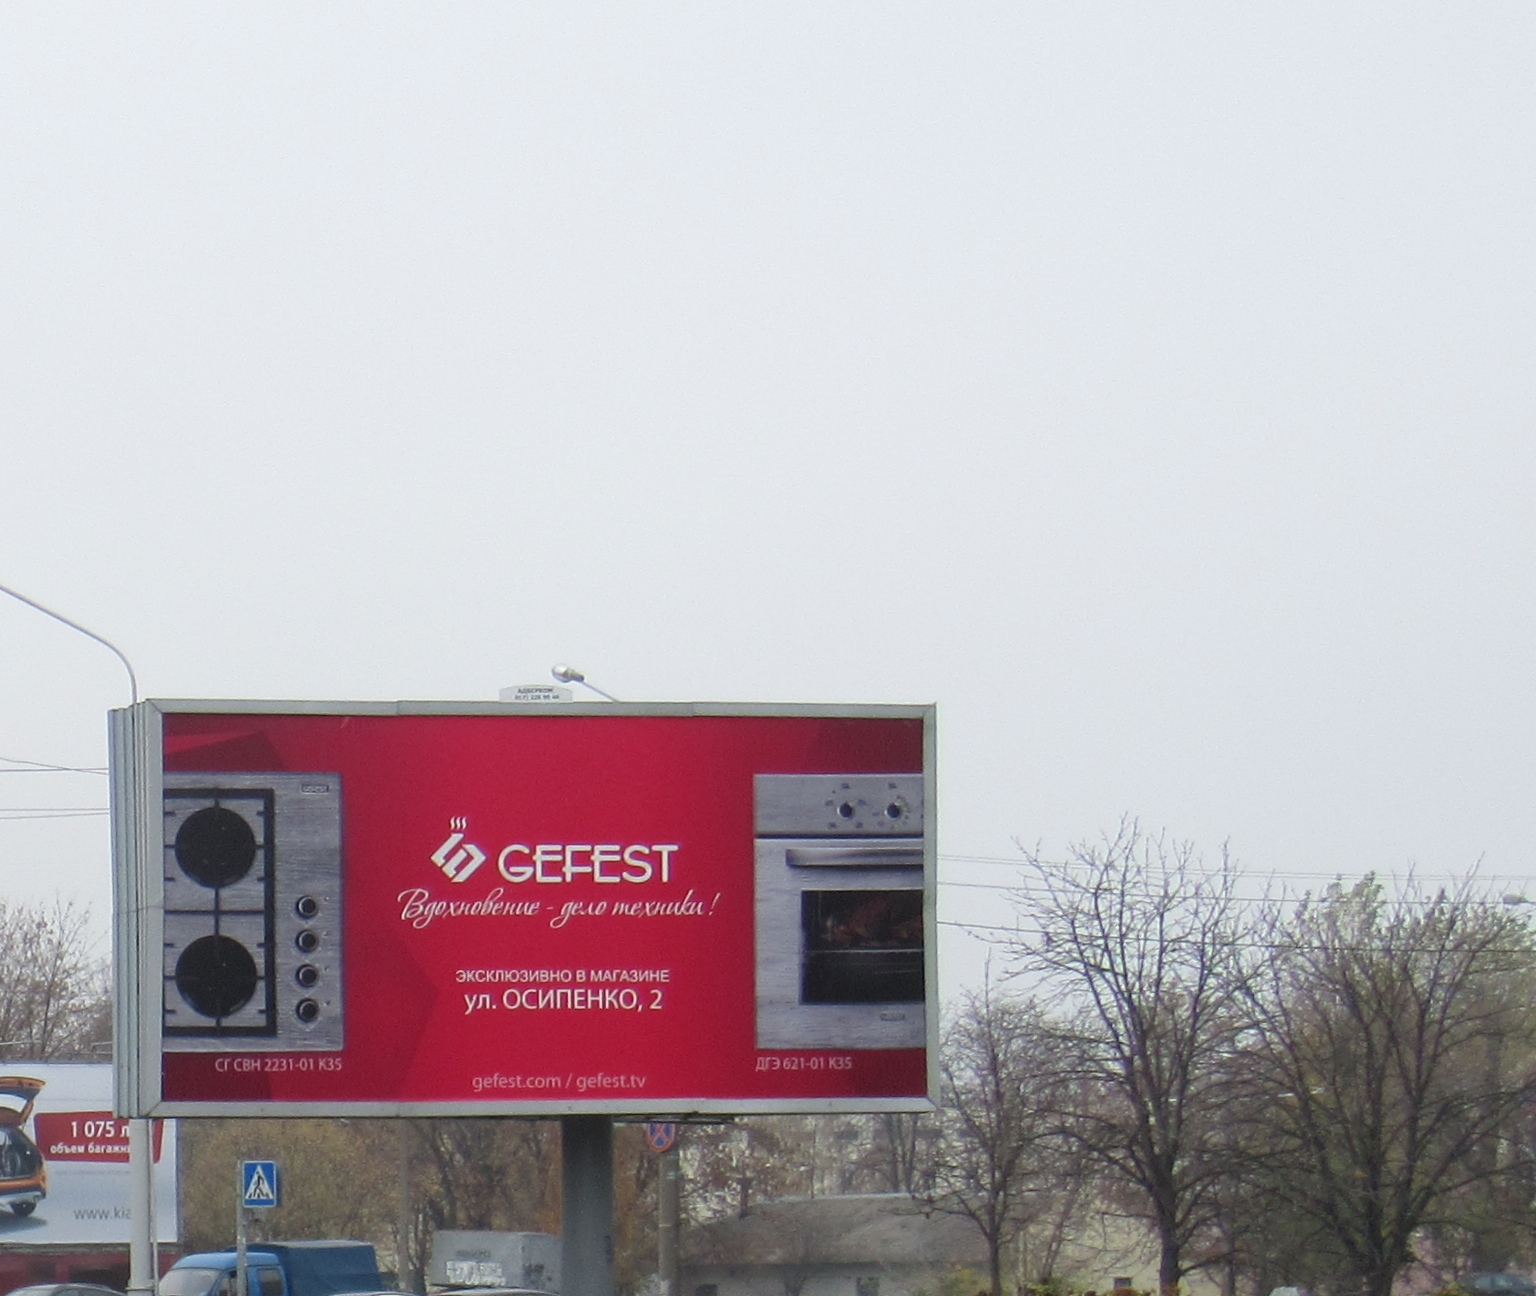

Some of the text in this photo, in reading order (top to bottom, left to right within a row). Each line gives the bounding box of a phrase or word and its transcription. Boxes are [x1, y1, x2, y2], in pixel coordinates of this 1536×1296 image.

[496, 844, 679, 883] GEFEST
[396, 887, 541, 929] Вдохновение
[549, 900, 608, 929] дело
[455, 969, 670, 984] ЭКСКЛЮЗИВНО В МАГАЗИНЕ
[463, 988, 664, 1015] ул. ОСИПЕНКО, 2
[263, 1058, 315, 1072] 2231-01
[755, 1056, 781, 1072] ДГЭ
[782, 1056, 824, 1071] 621-01
[472, 1072, 562, 1092] gefest.com
[576, 1072, 647, 1092] gefest.tv
[71, 1121, 77, 1138] 1
[84, 1120, 115, 1138] 075
[50, 1142, 85, 1154] объем
